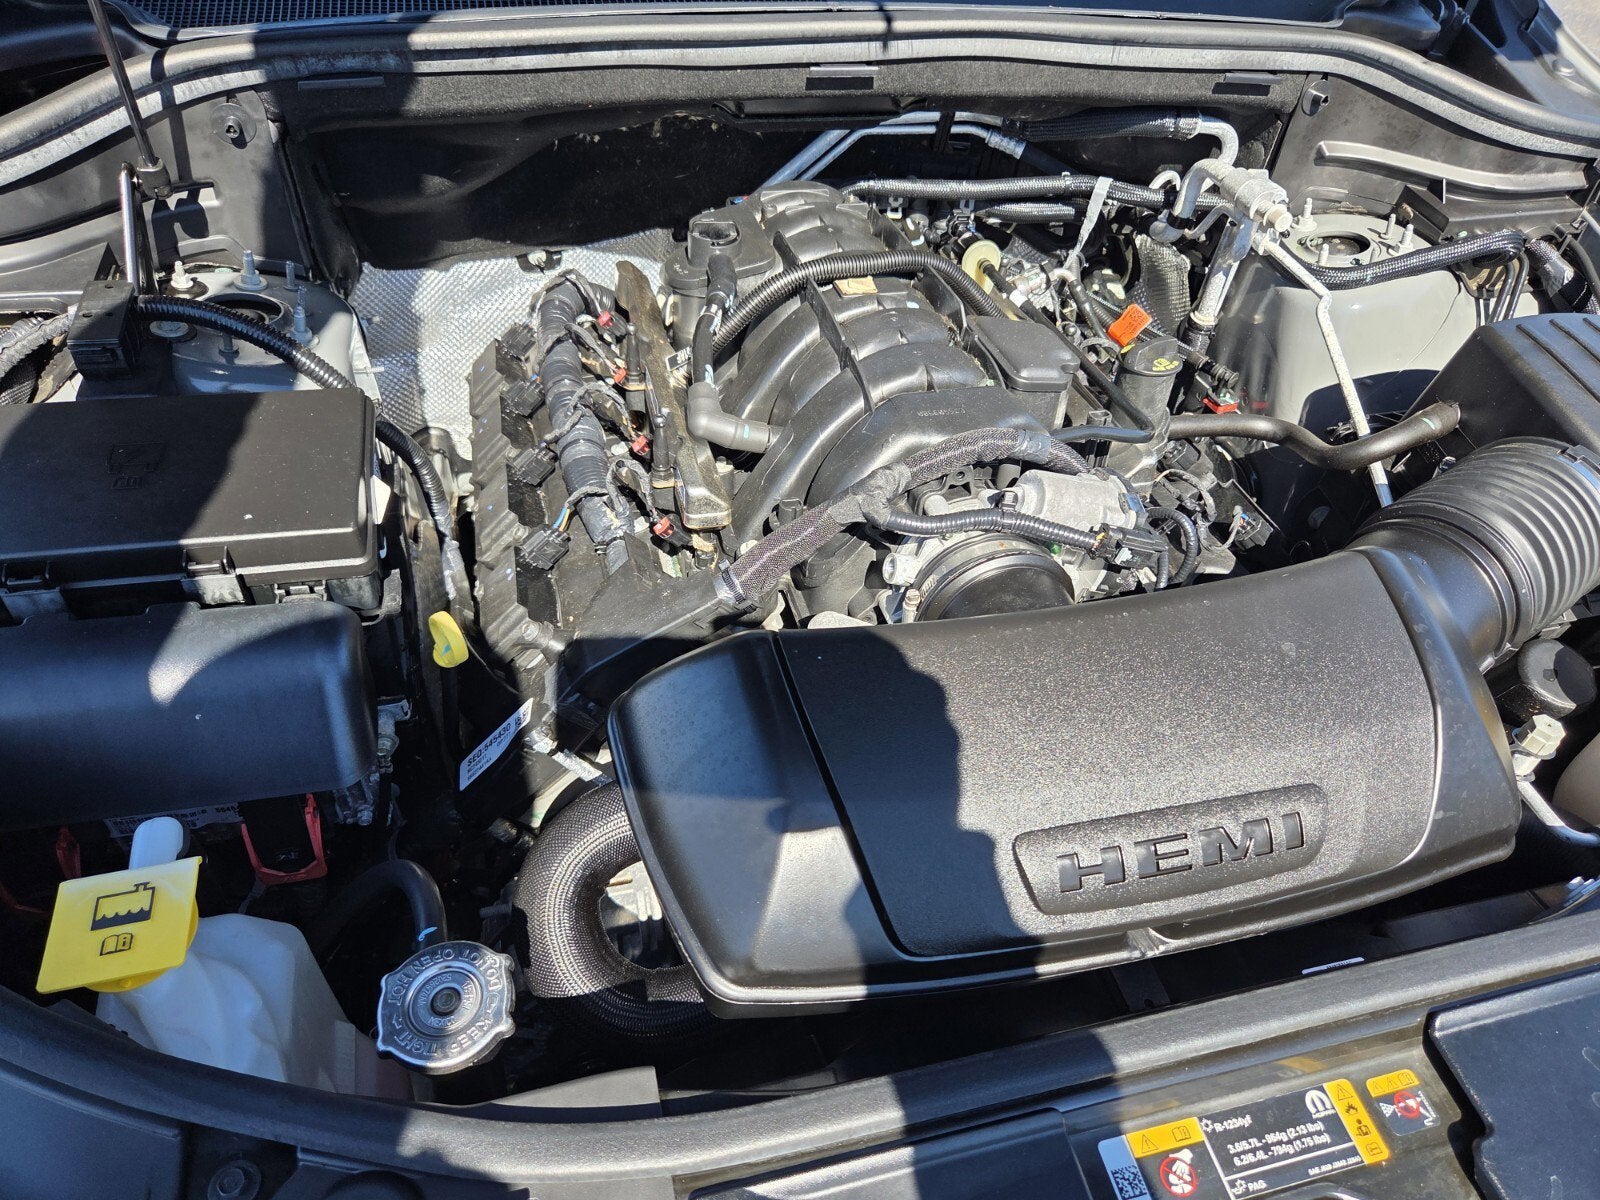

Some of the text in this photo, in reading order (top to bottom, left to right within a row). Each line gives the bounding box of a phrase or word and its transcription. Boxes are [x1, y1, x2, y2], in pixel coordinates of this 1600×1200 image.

[1056, 812, 1305, 893] HEMI
[411, 949, 455, 973] OPEN
[388, 972, 413, 1006] HOT
[485, 969, 503, 990] DO
[393, 1016, 494, 1056] KEEP TIGHT
[1213, 1114, 1252, 1132] R-1234yf
[1227, 1137, 1262, 1154] 3.6/5.7L
[1306, 1120, 1325, 1133] lbs)
[1233, 1149, 1268, 1166] 6.2/6.4L
[1312, 1132, 1331, 1146] lbs)
[1248, 1179, 1268, 1191] PAG
